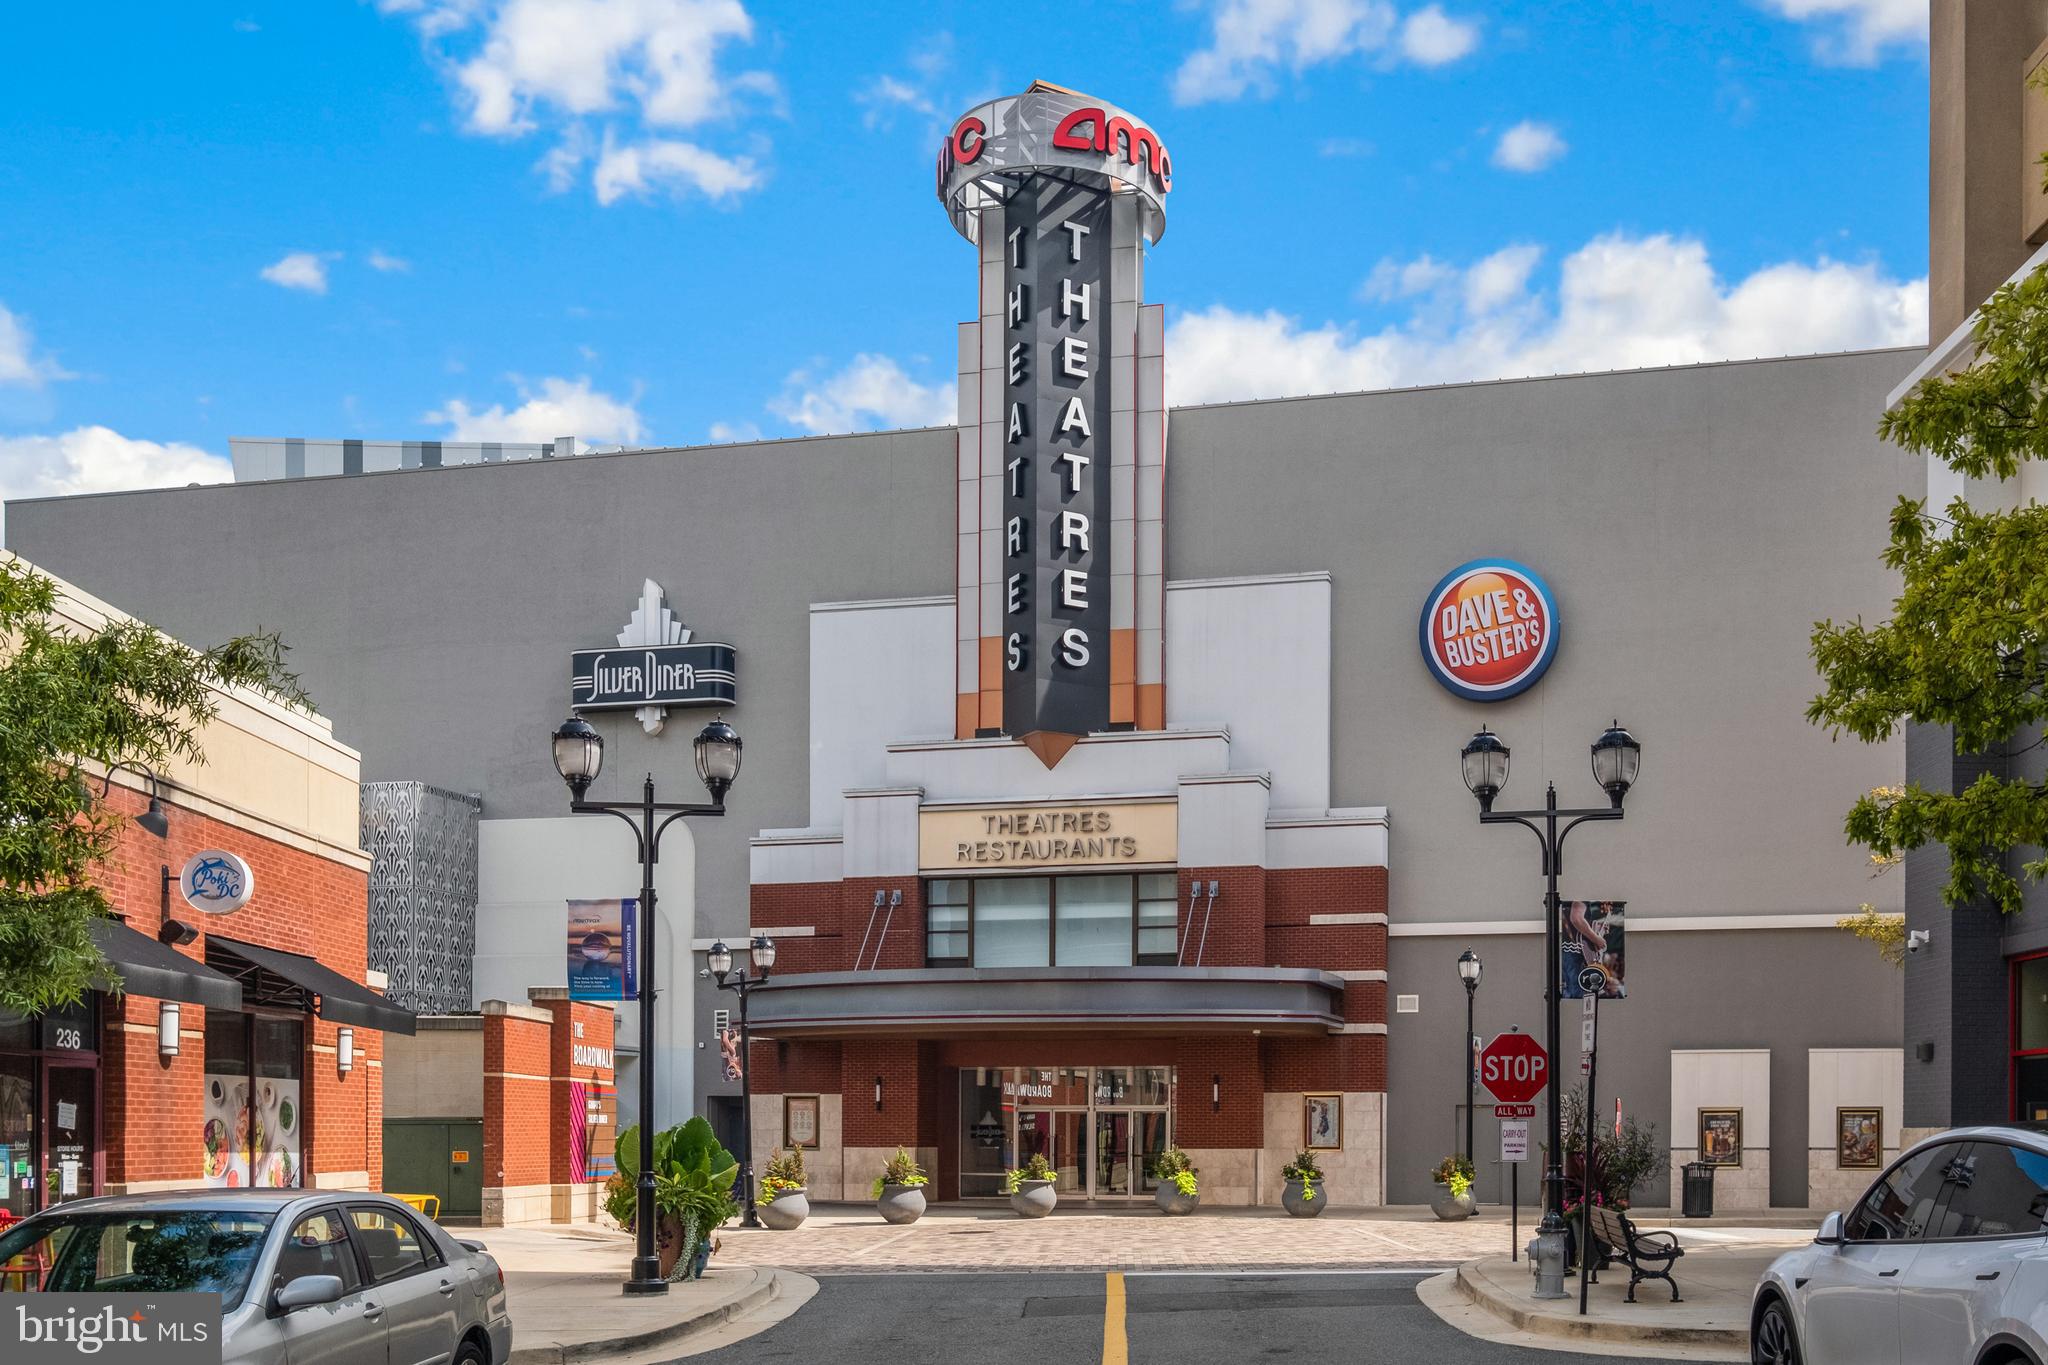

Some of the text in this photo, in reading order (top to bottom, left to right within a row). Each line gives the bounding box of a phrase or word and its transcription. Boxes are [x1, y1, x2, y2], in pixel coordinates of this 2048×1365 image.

[1007, 225, 1023, 672] THEATRES
[1062, 221, 1091, 668] THEATRES
[1442, 588, 1538, 639] DAVE &
[1444, 619, 1540, 668] BUSTER'S
[586, 651, 695, 702] SILVER DINER
[981, 811, 1112, 835] THEATRES
[956, 836, 1137, 861] RESTAURANTS
[196, 868, 229, 888] Poki
[217, 883, 240, 899] DC
[56, 1028, 80, 1050] 236
[573, 1021, 584, 1039] THE
[573, 1044, 614, 1069] BOARDWALK
[1485, 1055, 1545, 1081] STOP
[1497, 1106, 1533, 1116] ALL WAY
